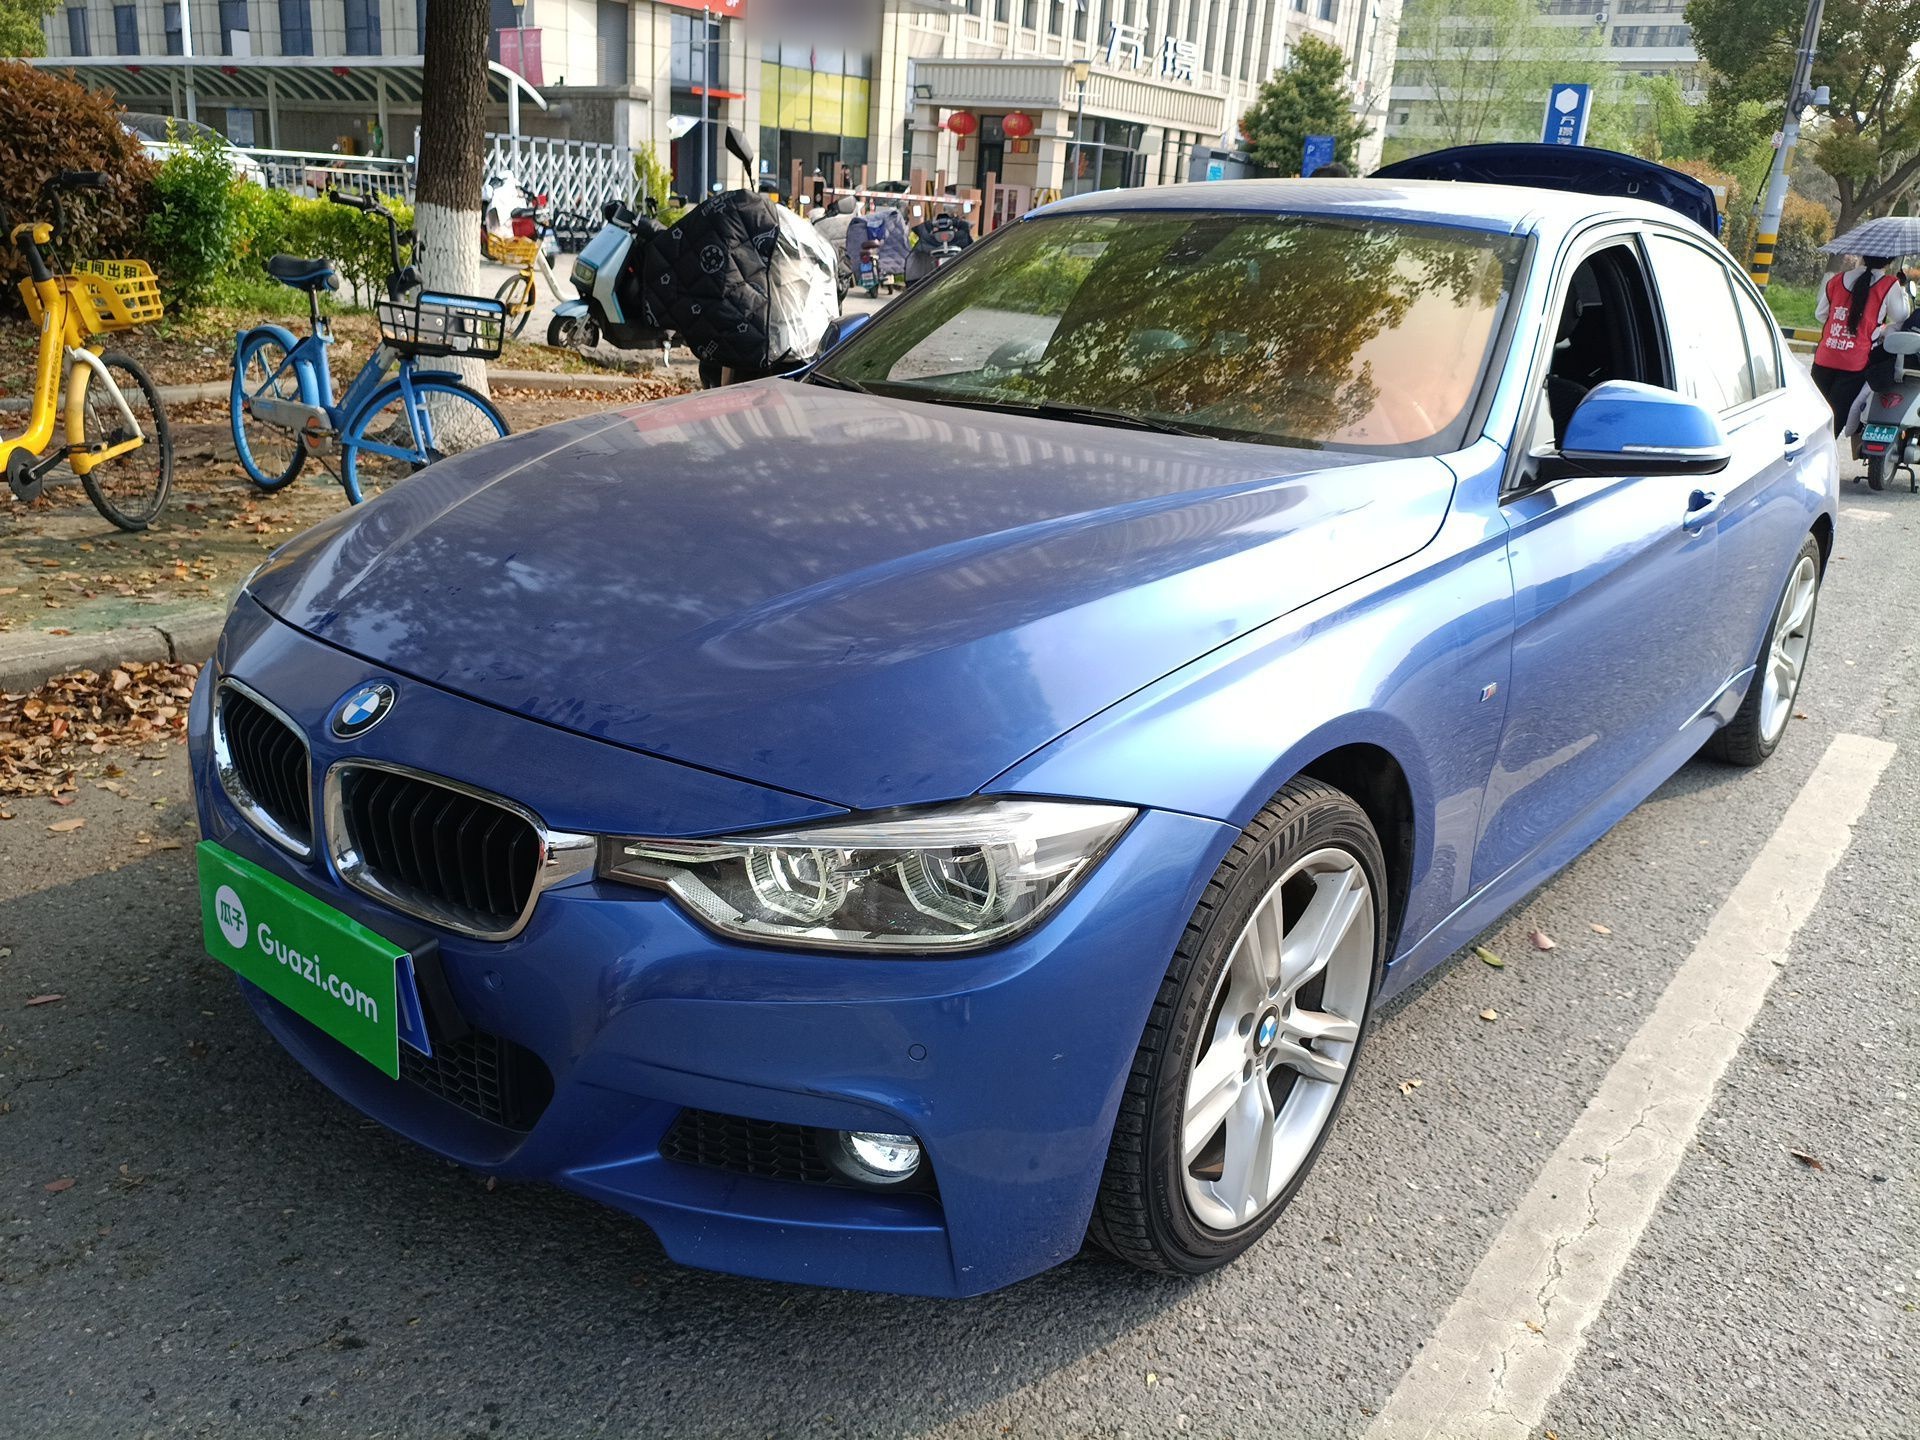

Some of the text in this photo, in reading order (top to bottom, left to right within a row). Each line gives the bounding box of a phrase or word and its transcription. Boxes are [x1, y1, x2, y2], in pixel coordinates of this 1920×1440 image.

[220, 900, 245, 932] 瓜子
[257, 922, 378, 1024] Guazi.com
[1173, 992, 1197, 1055] RFT
